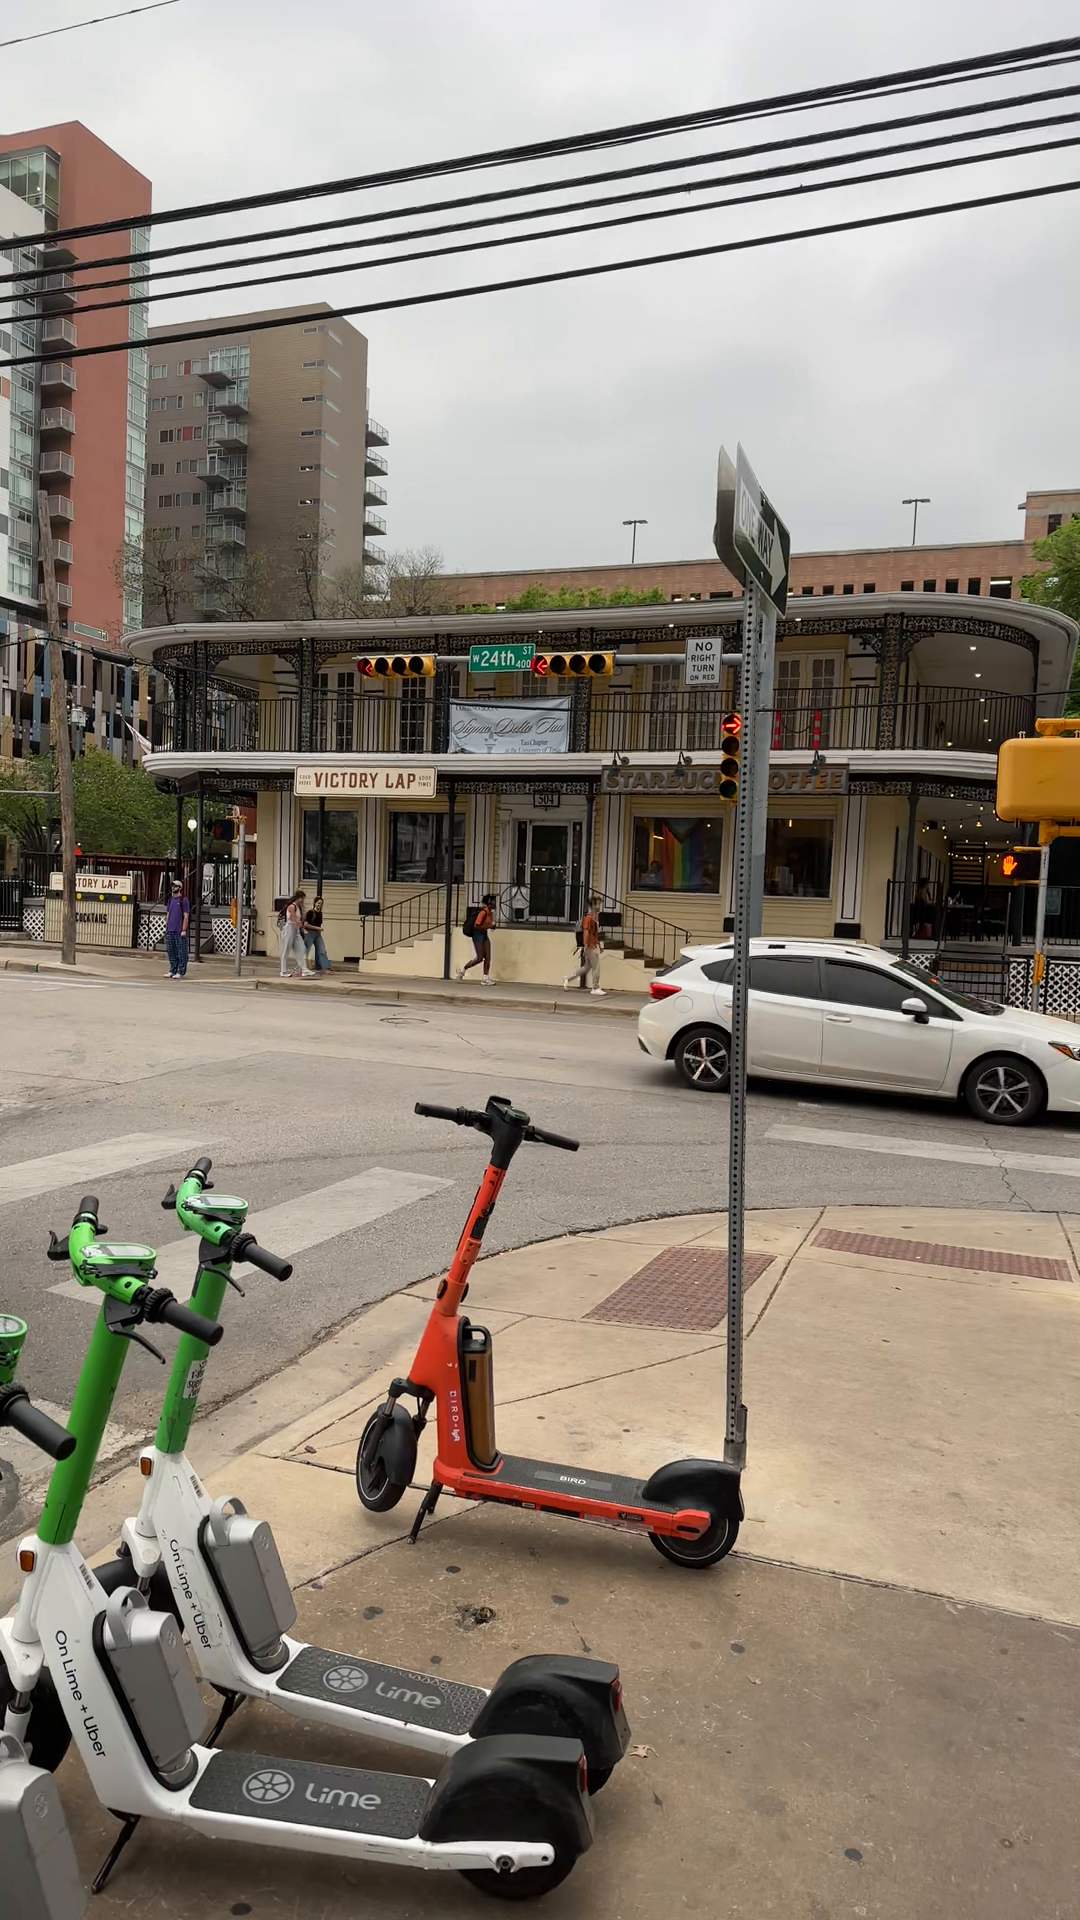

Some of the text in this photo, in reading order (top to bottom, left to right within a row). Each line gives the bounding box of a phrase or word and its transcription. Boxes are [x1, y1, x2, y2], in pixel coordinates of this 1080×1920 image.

[741, 490, 774, 568] ONE WAY
[695, 641, 713, 651] NO
[472, 646, 532, 667] W 24th ST
[515, 659, 532, 669] 400
[690, 653, 717, 662] RIGHT
[692, 664, 715, 672] TURN
[702, 673, 716, 681] RED
[453, 716, 566, 740] Sigma Delta Tau
[314, 772, 416, 789] VICTORY LAP
[606, 770, 844, 789] STARBUC OFFEE
[538, 794, 554, 805] 504
[101, 879, 119, 890] LAP
[75, 912, 107, 924] COCKTAILS
[449, 1390, 460, 1422] BIRD
[559, 1475, 587, 1485] BIRD
[169, 1539, 181, 1562] On
[175, 1564, 193, 1600] Lime
[193, 1613, 212, 1649] Uber
[55, 1630, 68, 1656] On
[62, 1659, 83, 1701] Lime
[83, 1716, 107, 1757] Uber
[375, 1681, 441, 1709] Lime
[305, 1782, 382, 1810] Lime
